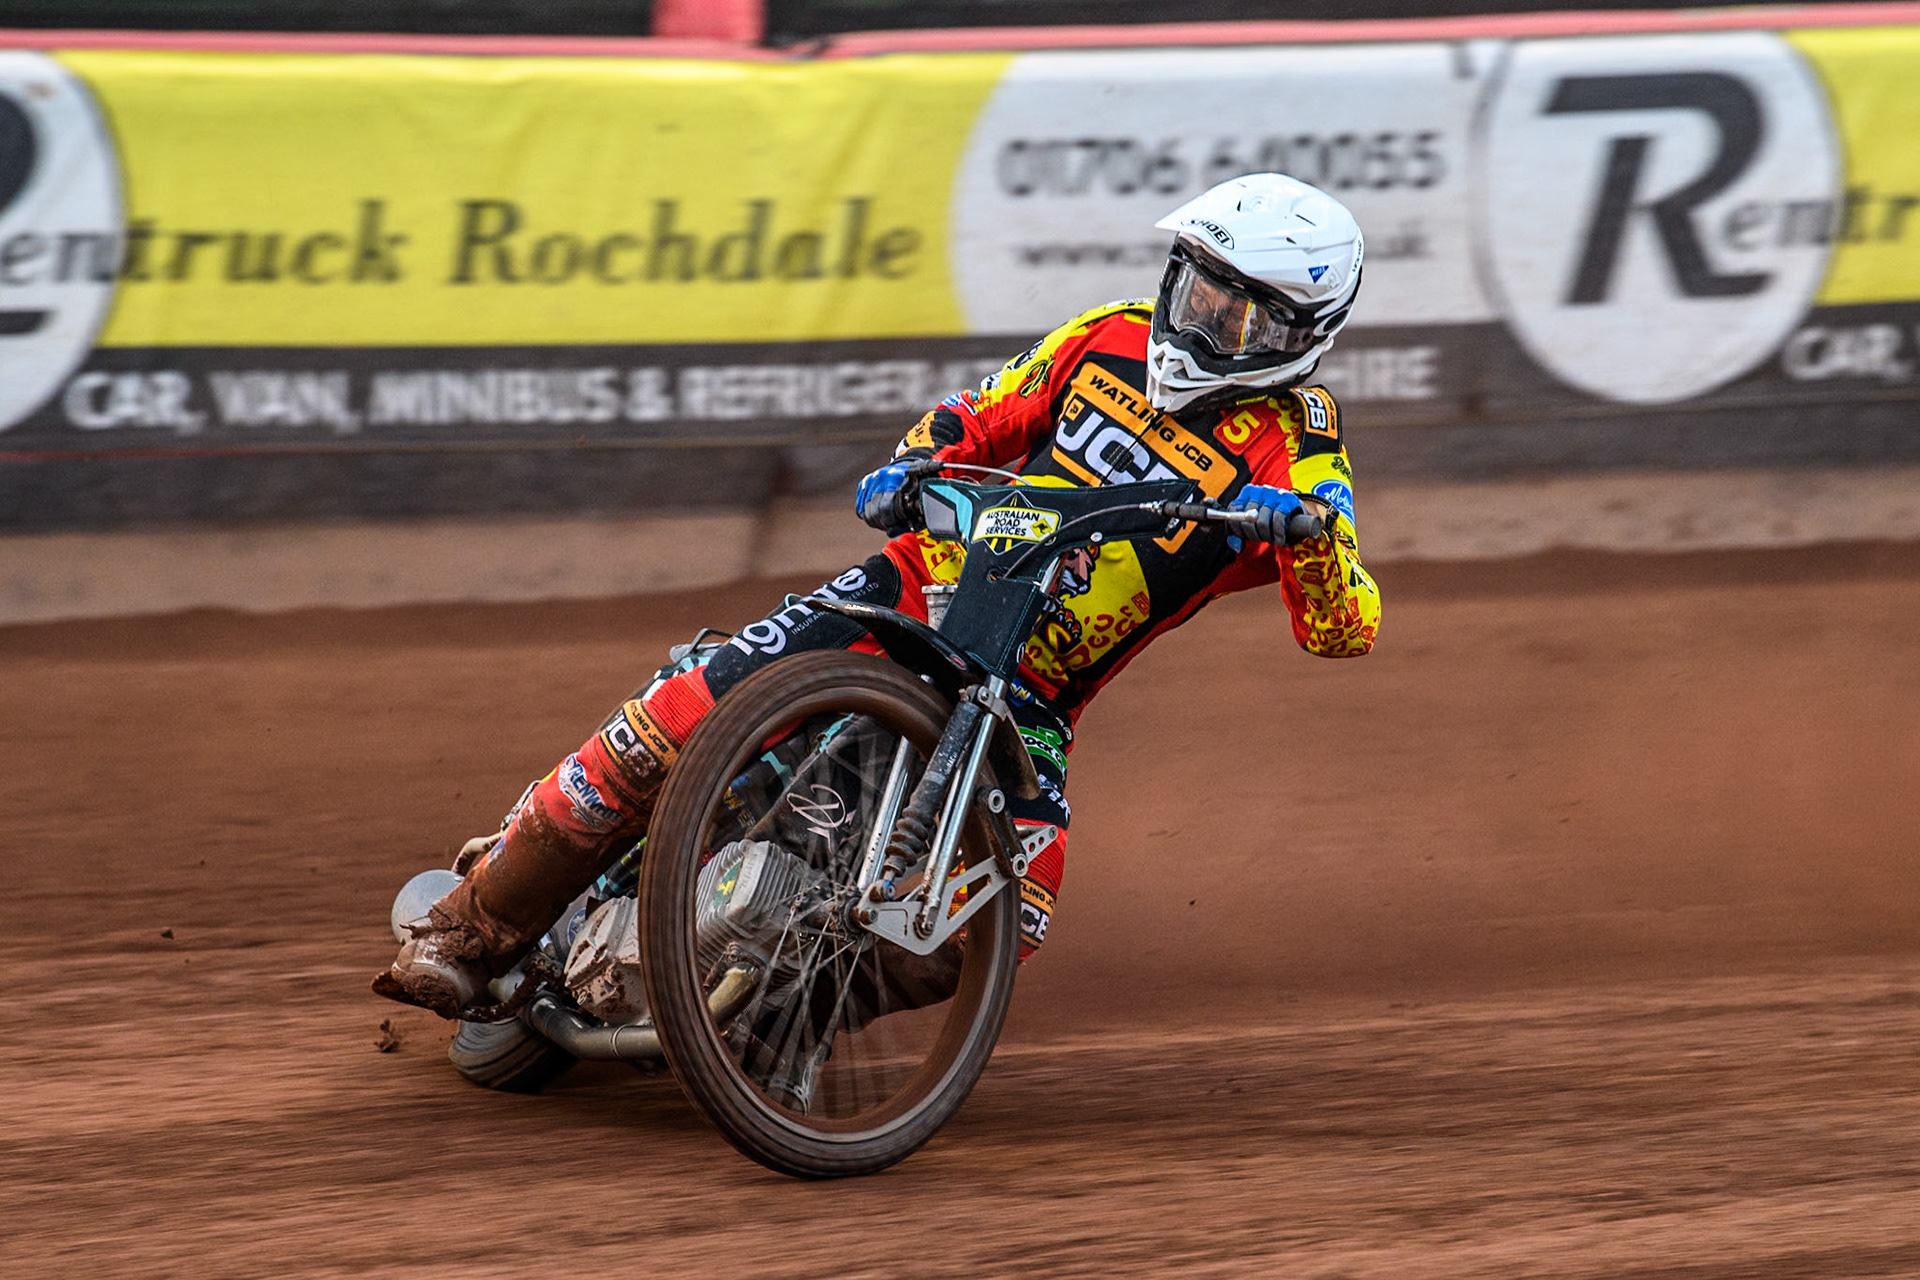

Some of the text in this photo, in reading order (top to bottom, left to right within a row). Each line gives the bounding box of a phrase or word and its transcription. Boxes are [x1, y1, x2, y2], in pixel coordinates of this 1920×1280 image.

[447, 195, 923, 288] Rochdale
[368, 367, 619, 425] MINIBUS
[626, 365, 675, 423] &
[1089, 374, 1177, 443] WATLING
[1174, 442, 1213, 472] JCB
[1223, 410, 1260, 444] 5
[986, 510, 1040, 521] AUSTRALIAN
[994, 518, 1020, 527] ROAD
[985, 526, 1026, 537] SERVICES
[648, 732, 669, 754] JCB
